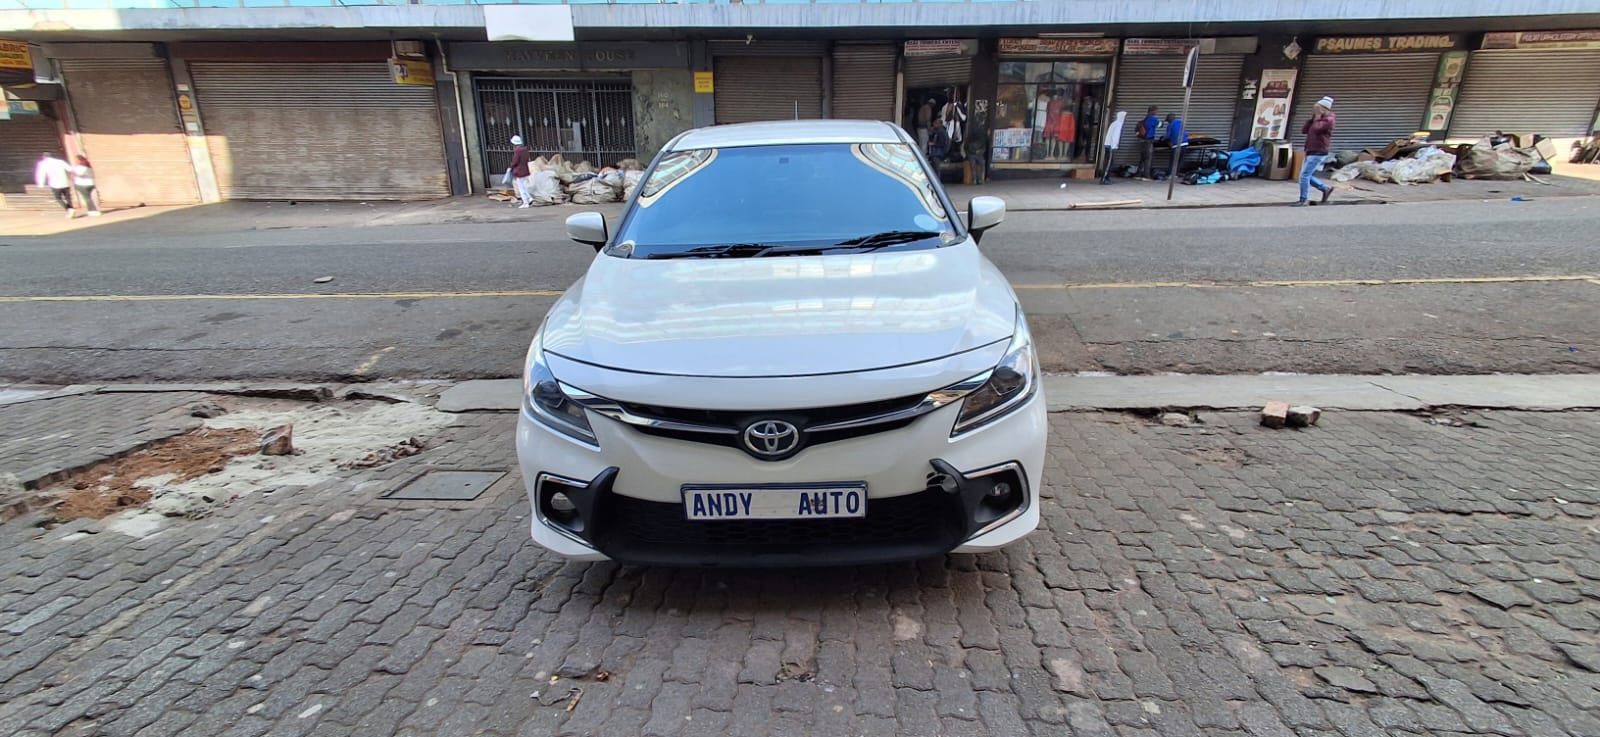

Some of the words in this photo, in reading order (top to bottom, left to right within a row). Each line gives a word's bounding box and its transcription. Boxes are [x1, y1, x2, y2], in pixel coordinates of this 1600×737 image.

[1317, 37, 1383, 51] PSAUMES
[693, 493, 753, 516] ANDY
[799, 491, 860, 515] AUTO
